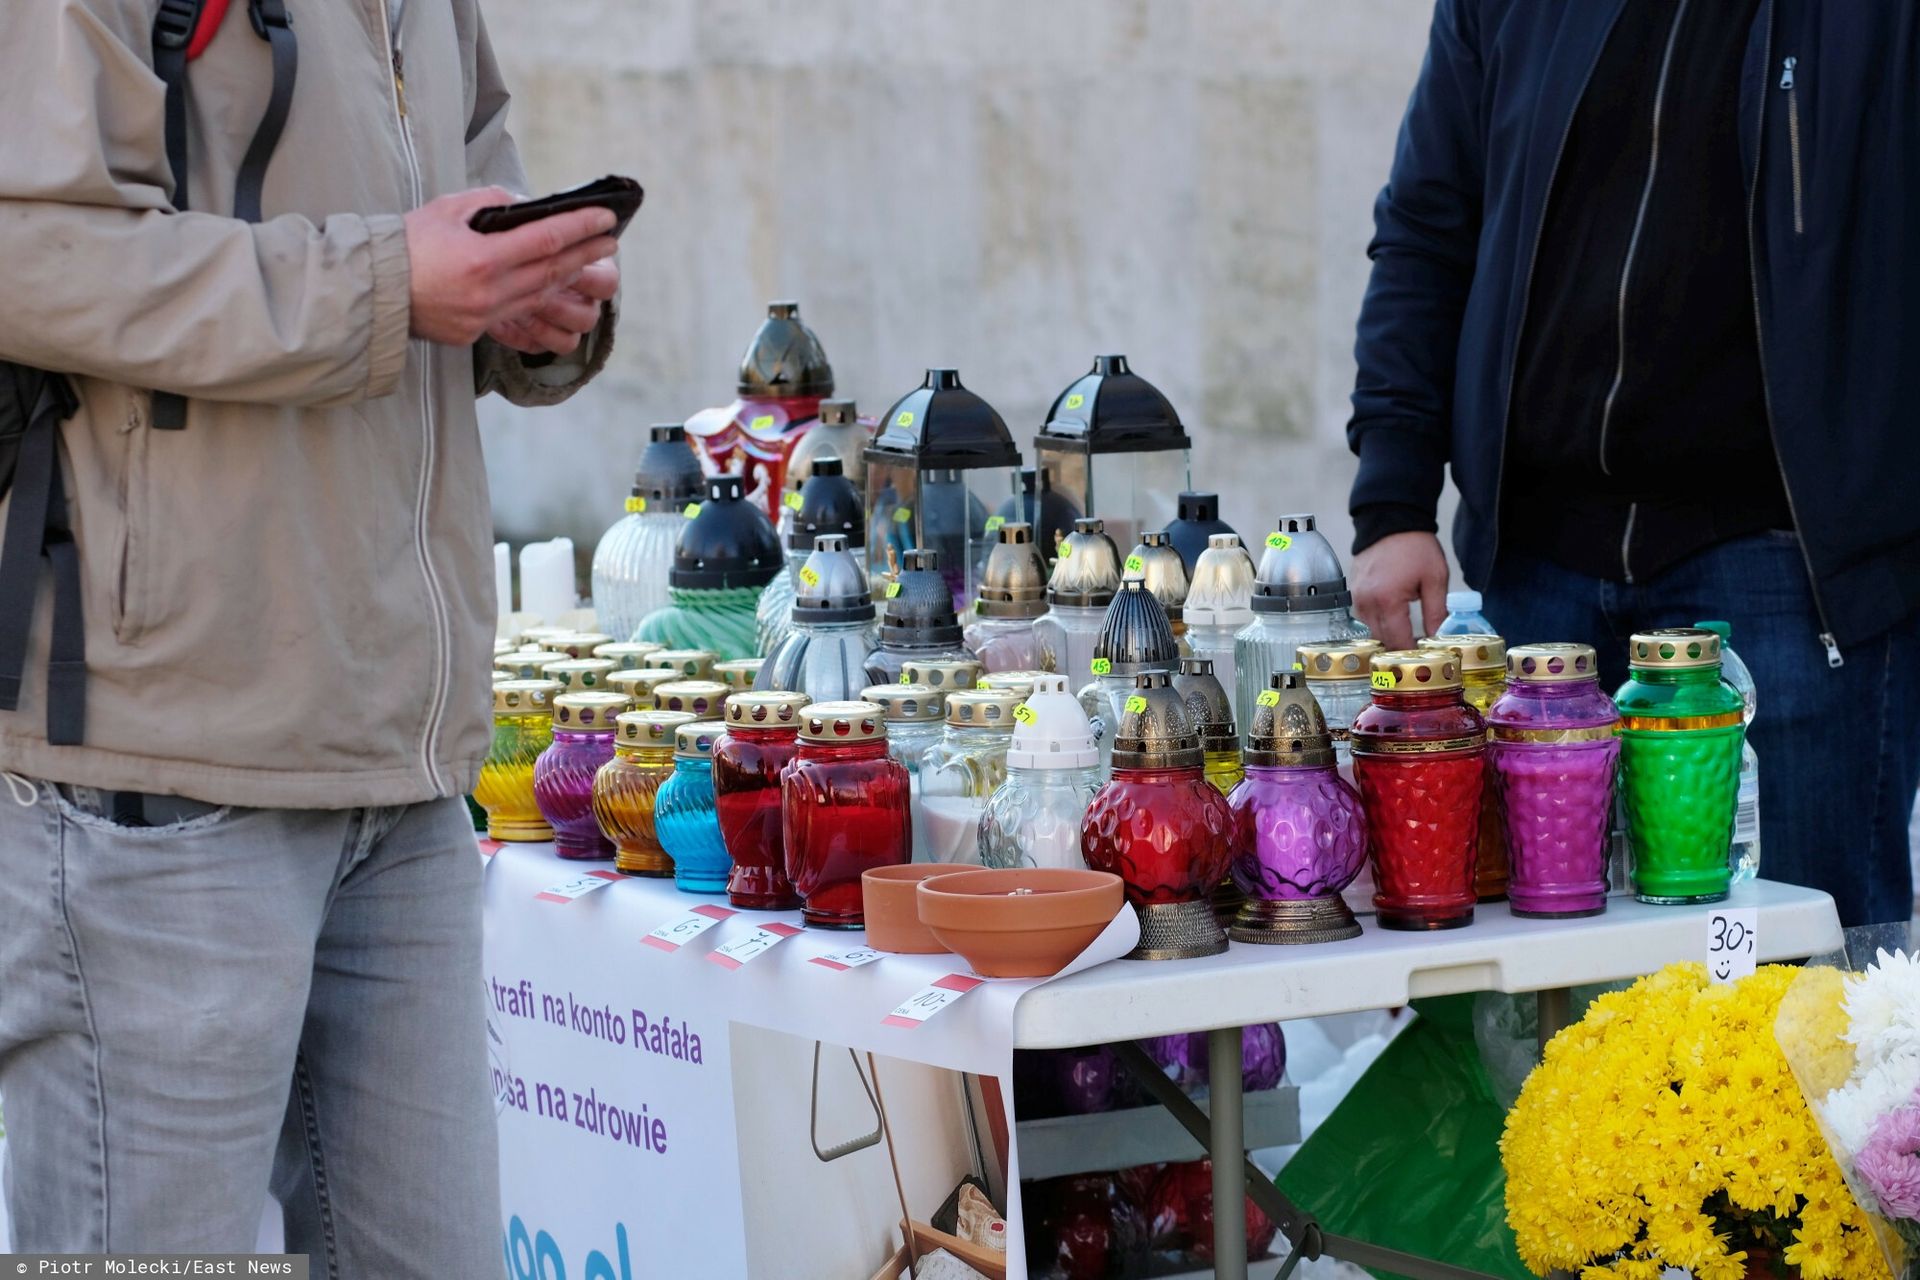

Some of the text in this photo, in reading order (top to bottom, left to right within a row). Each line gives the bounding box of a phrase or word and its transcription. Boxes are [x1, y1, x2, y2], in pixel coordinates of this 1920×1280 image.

[492, 976, 703, 1065] trafi na konto Rafała
[536, 1082, 568, 1122] na
[573, 1087, 667, 1154] zdrowie
